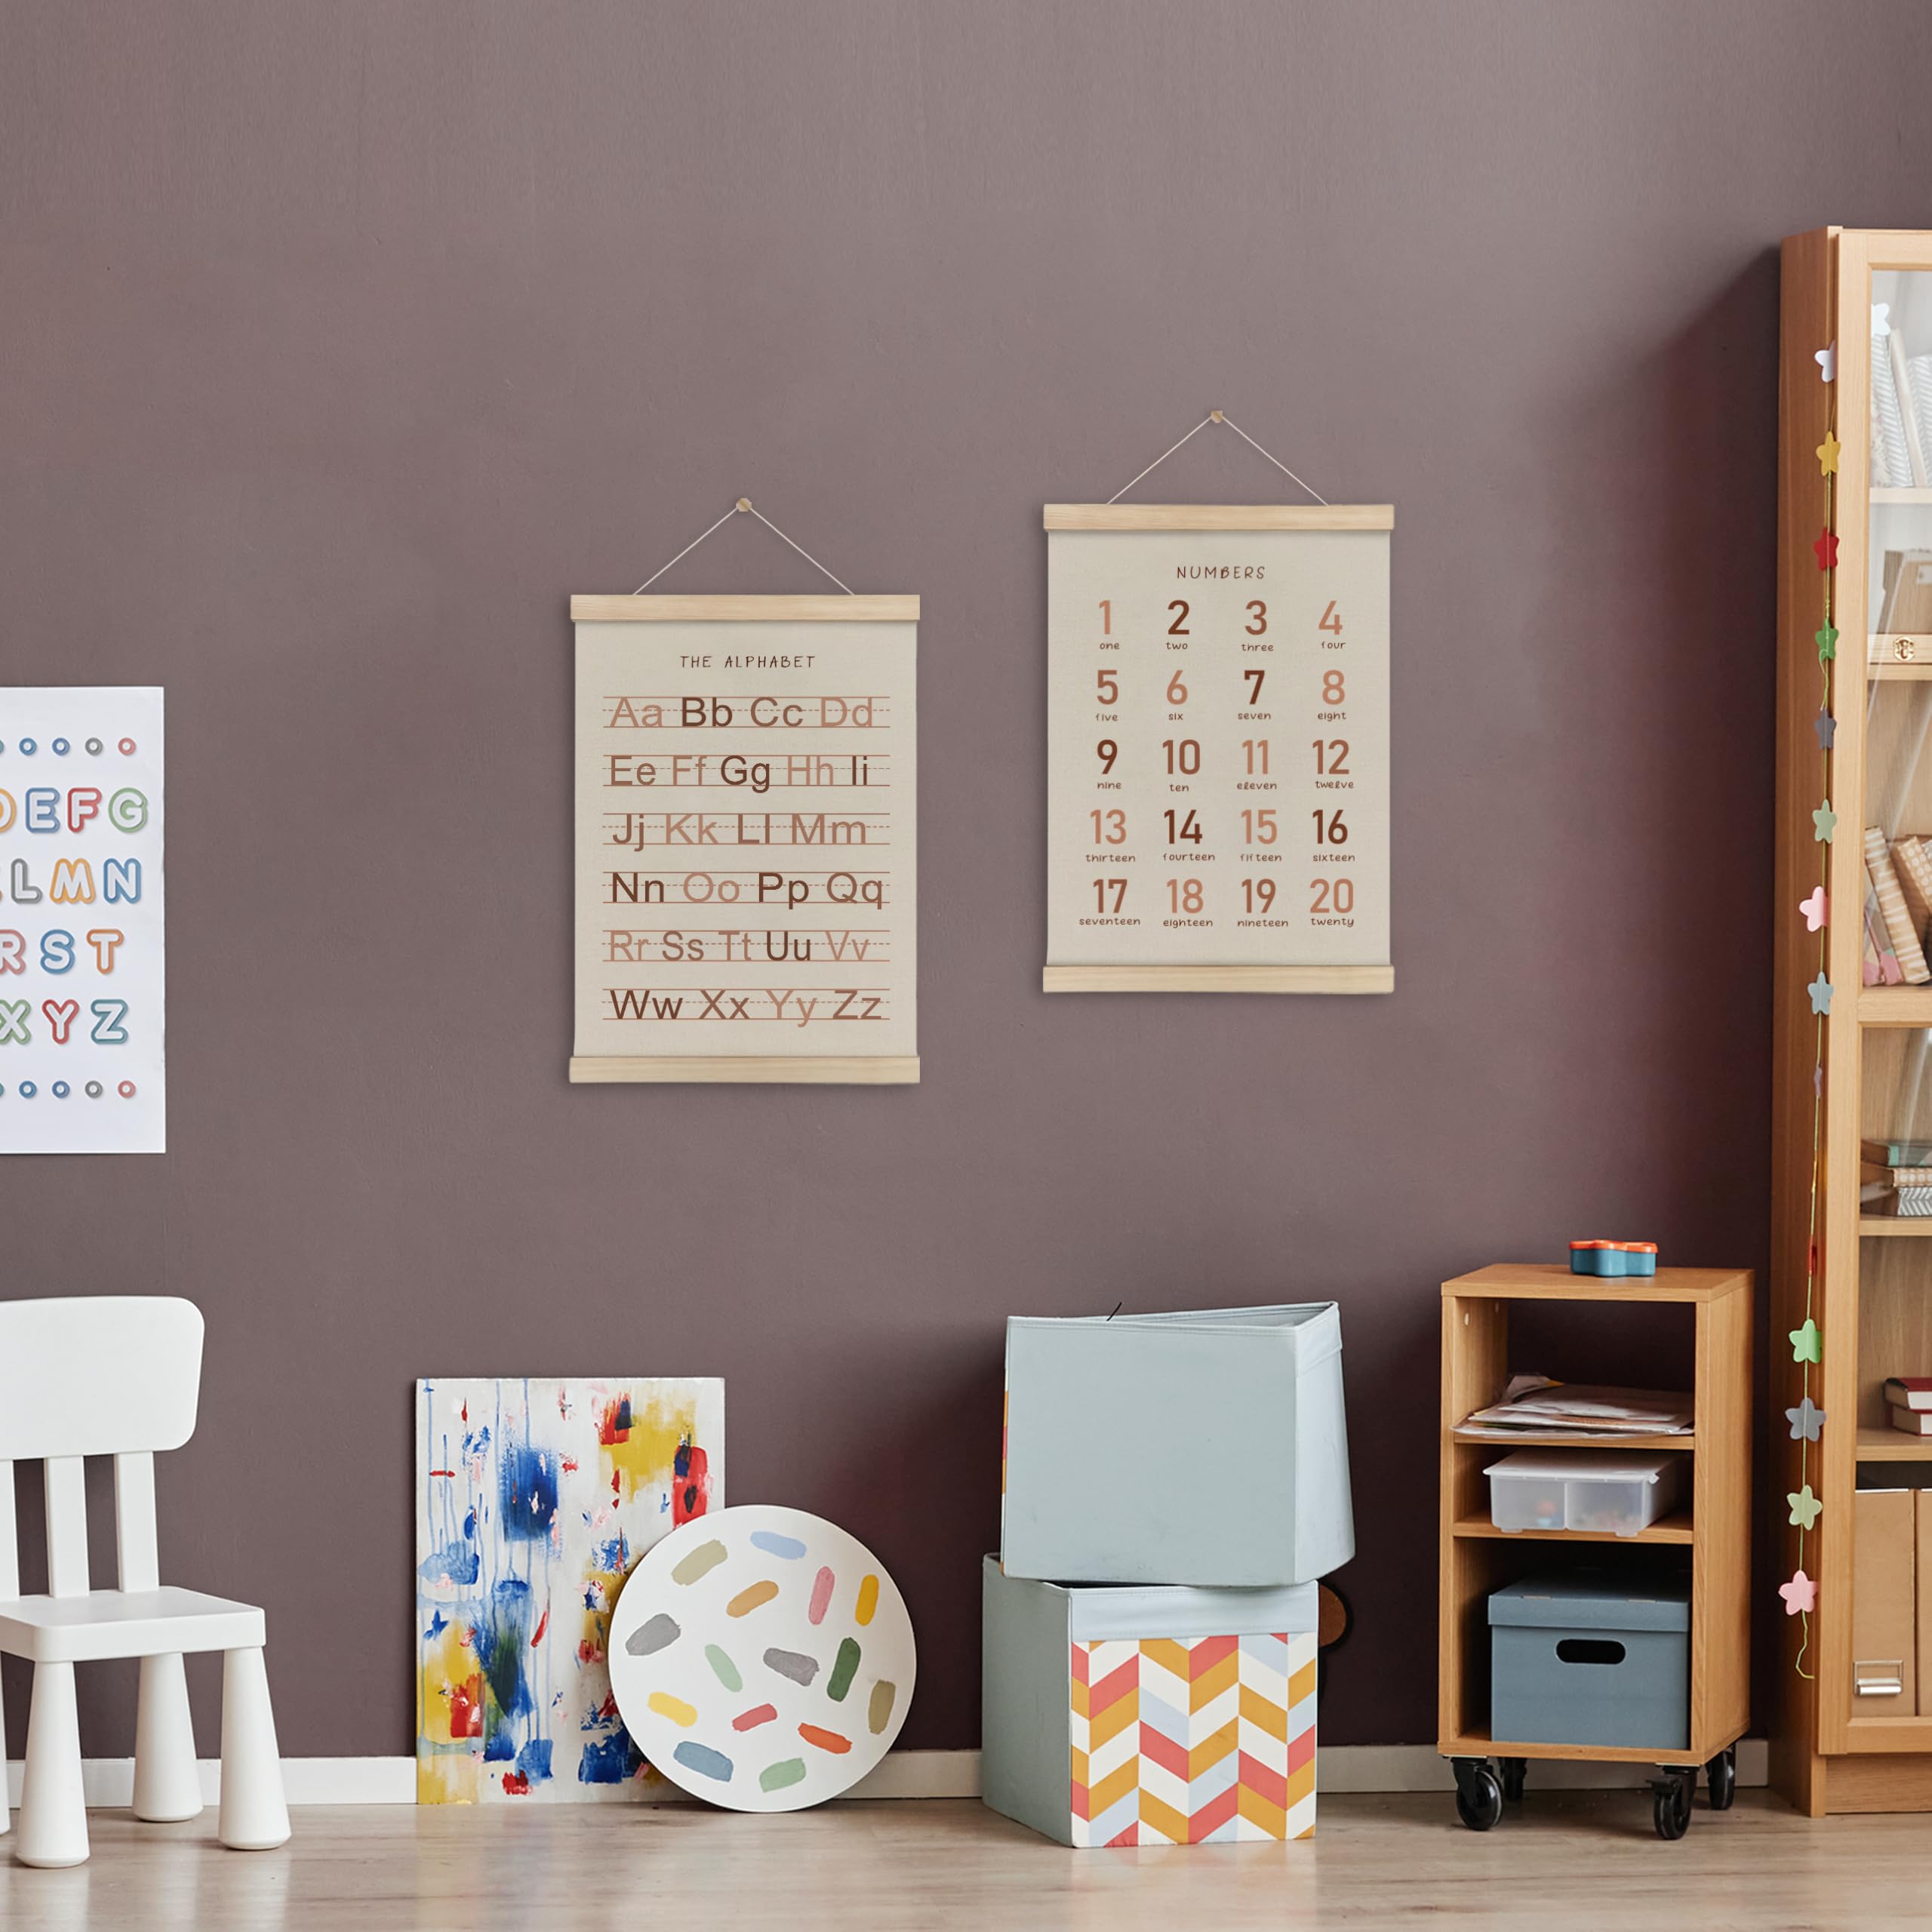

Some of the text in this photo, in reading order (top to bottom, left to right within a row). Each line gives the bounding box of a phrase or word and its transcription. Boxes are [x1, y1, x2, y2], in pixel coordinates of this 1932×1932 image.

[1177, 566, 1265, 579] NUMBERS
[1099, 600, 1343, 635] 1 2 3 4
[680, 655, 815, 668] THE ALPHABET
[1099, 641, 1347, 652] one two three four
[1097, 669, 1345, 705] 5 6 7 8
[609, 697, 874, 728] Aa Bb Cc Dd
[1095, 712, 1347, 722] five six seven eight
[611, 755, 869, 793] Ee Ff Gg Hh Ii
[1097, 740, 1349, 775] 9 10 11 12
[1097, 780, 1355, 792] nine ten eleven twelve
[612, 814, 867, 852] Jj Kk Ll Mm
[1091, 809, 1348, 844] 13 14 15 16
[1084, 852, 1355, 863] thirteen fourteen fifteen sixteen
[612, 872, 883, 909] Nn Oo Pp Qq
[1093, 878, 1353, 913] 17 18 19 20
[1078, 917, 1355, 929] seventeen eighteen nineteen twenty
[611, 931, 870, 961] Rr Ss Tt Uu Vv
[610, 989, 882, 1028] Ww Xx Yy Zz
